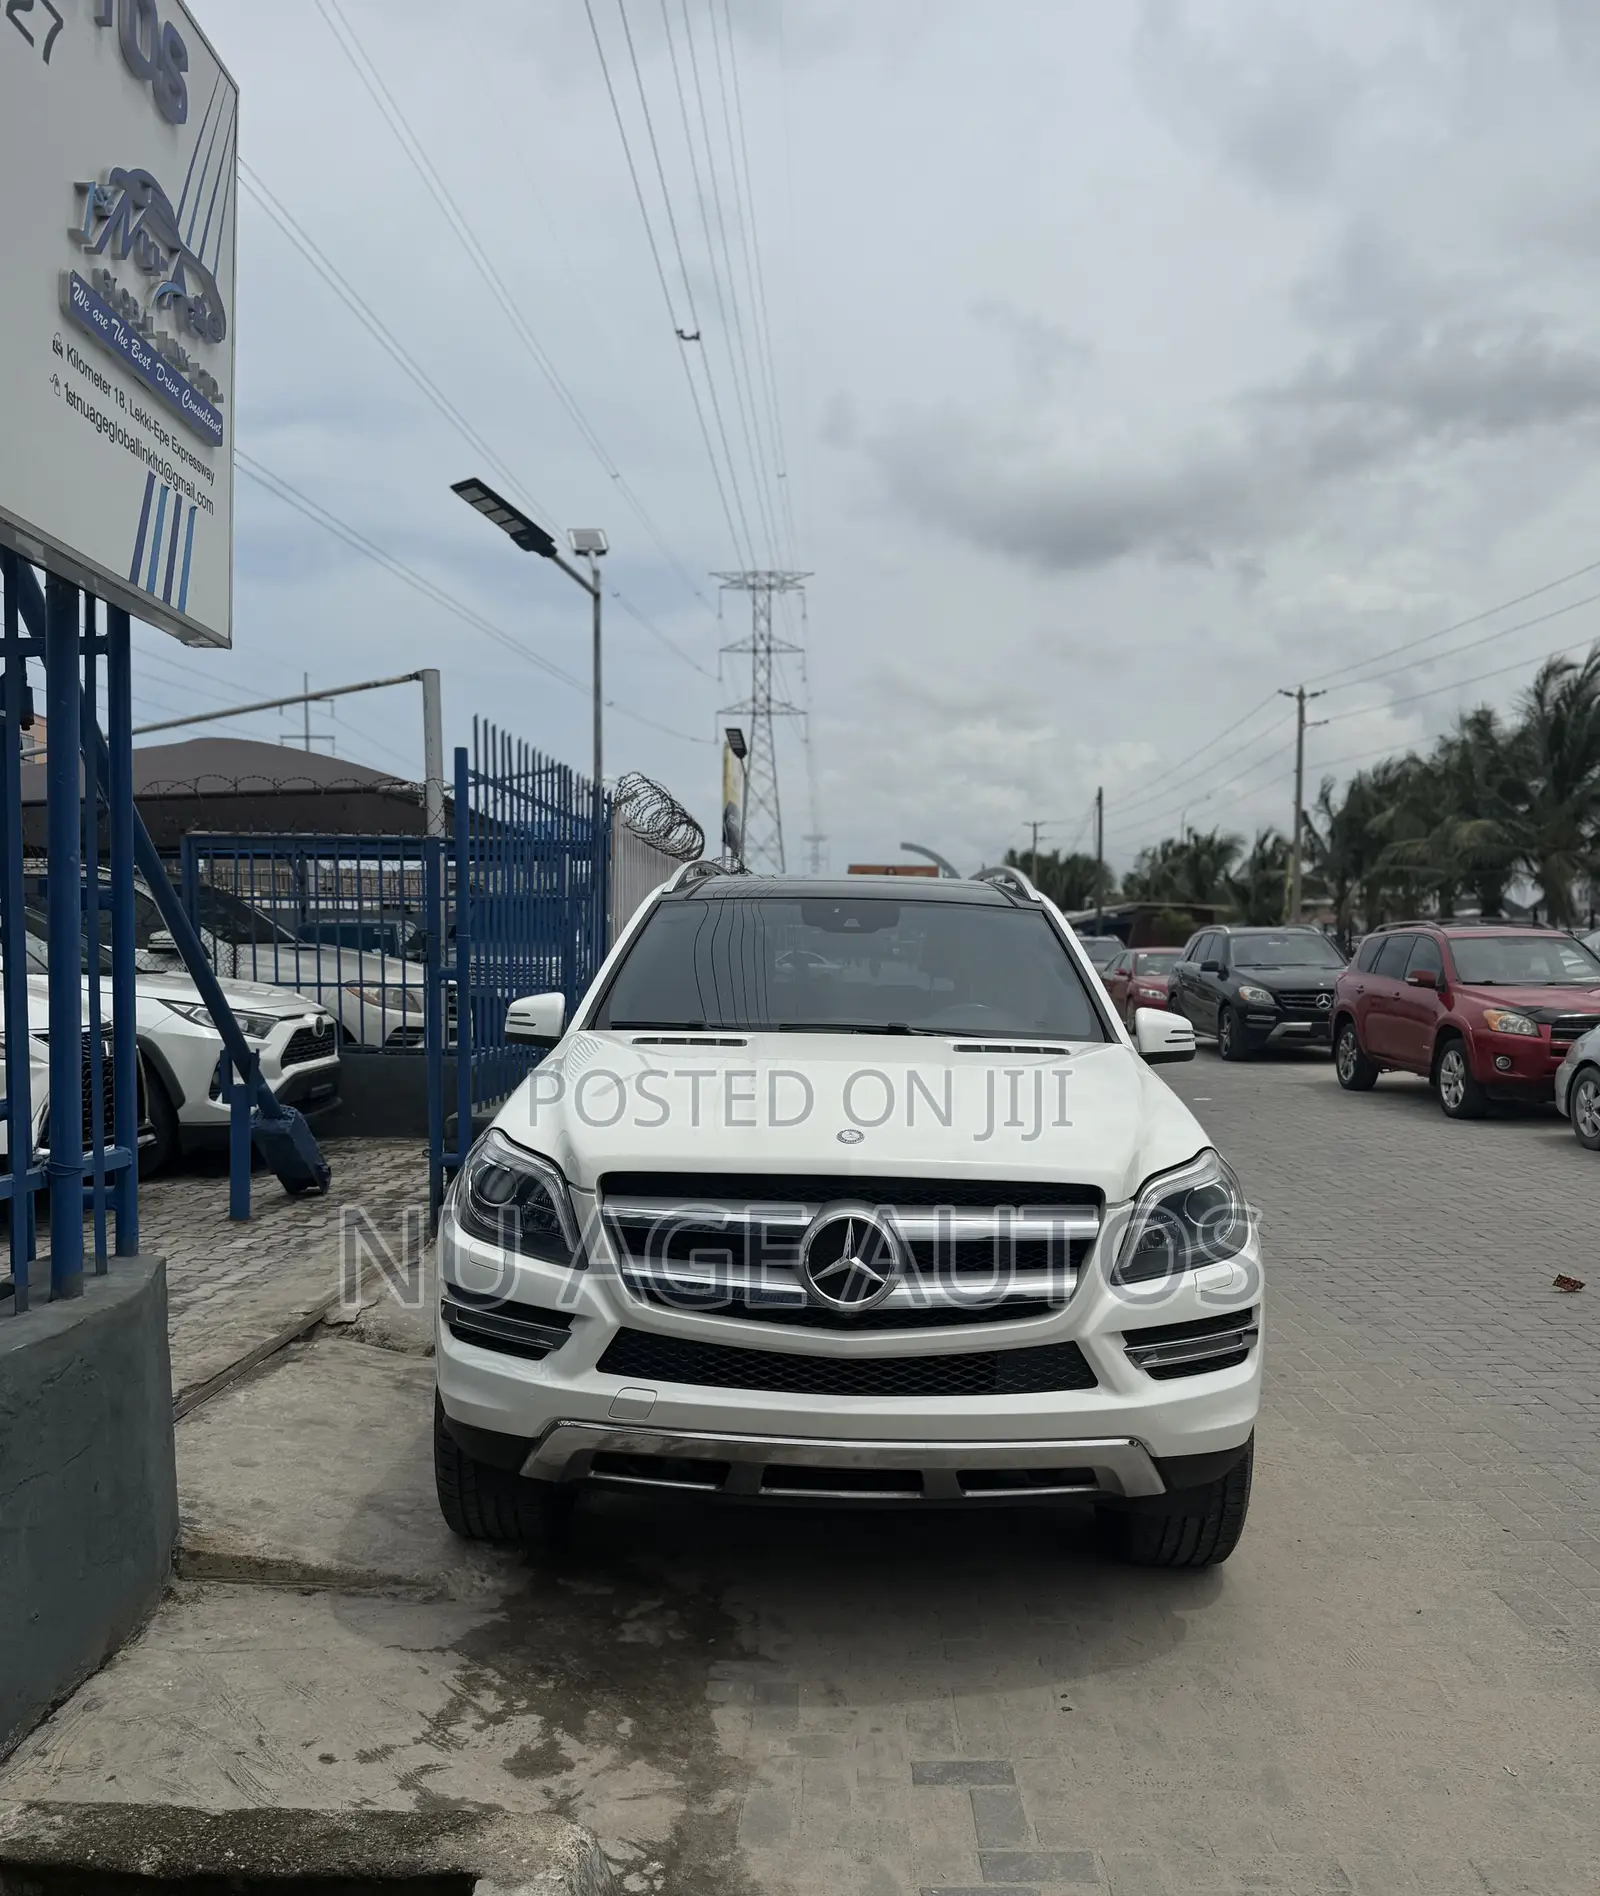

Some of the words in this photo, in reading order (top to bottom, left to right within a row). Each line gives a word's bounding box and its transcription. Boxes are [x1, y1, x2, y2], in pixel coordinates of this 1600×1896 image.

[66, 343, 111, 398] Kilometer
[114, 386, 128, 414] 18,
[129, 398, 170, 446] Lekki-Epe
[171, 435, 215, 487] Expressway
[72, 281, 90, 312] We
[92, 309, 109, 330] are
[111, 317, 128, 349] The
[131, 338, 152, 370] Best
[156, 362, 179, 397] Drive
[181, 389, 222, 435] Consultant
[64, 381, 214, 516] 1stnuagegloballinkltd@gmail.com
